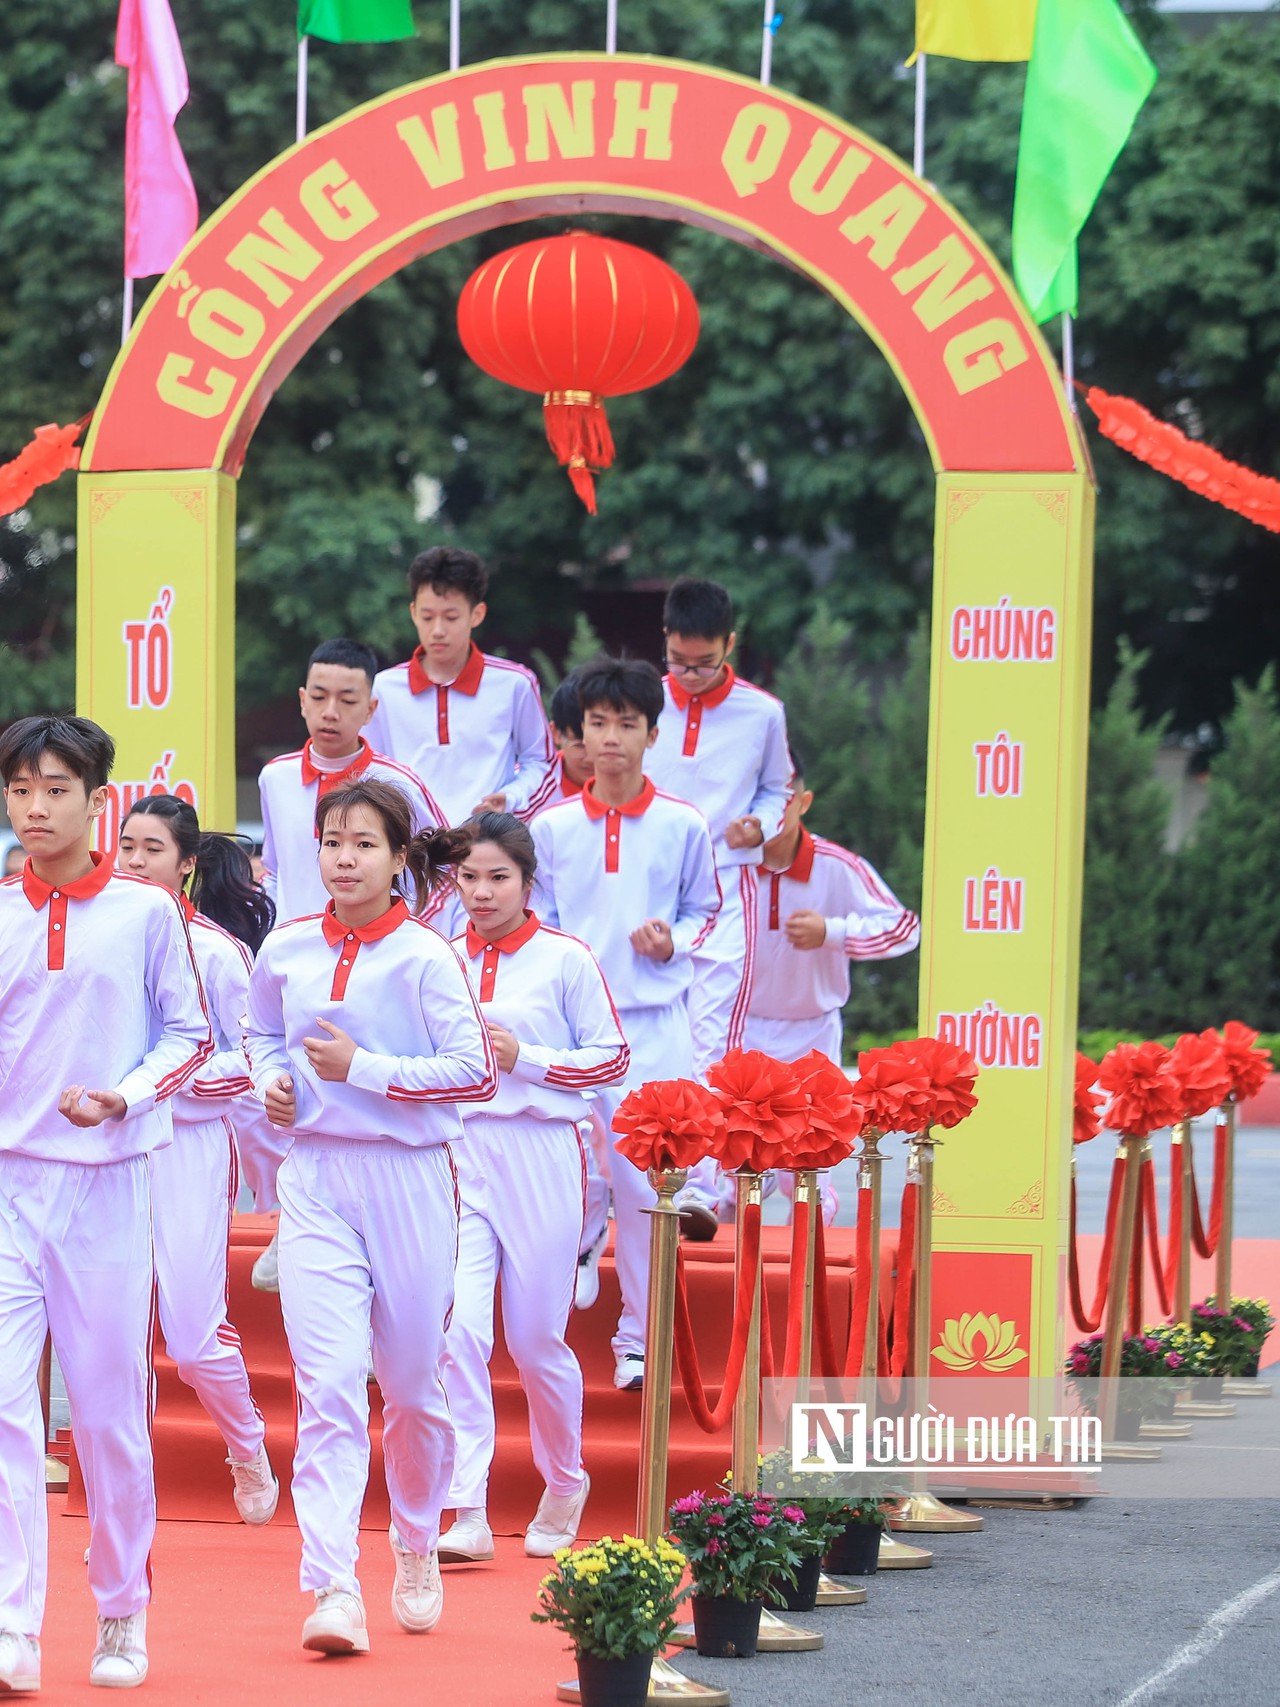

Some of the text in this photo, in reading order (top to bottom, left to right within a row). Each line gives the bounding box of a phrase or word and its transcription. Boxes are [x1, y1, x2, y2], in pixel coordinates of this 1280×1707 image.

[155, 79, 1029, 419] CỔNG VINH QUANG
[125, 588, 172, 707] TỔ
[952, 598, 1056, 661] CHÚNG
[975, 734, 1022, 796] TÔI
[965, 869, 1023, 932] LÊN
